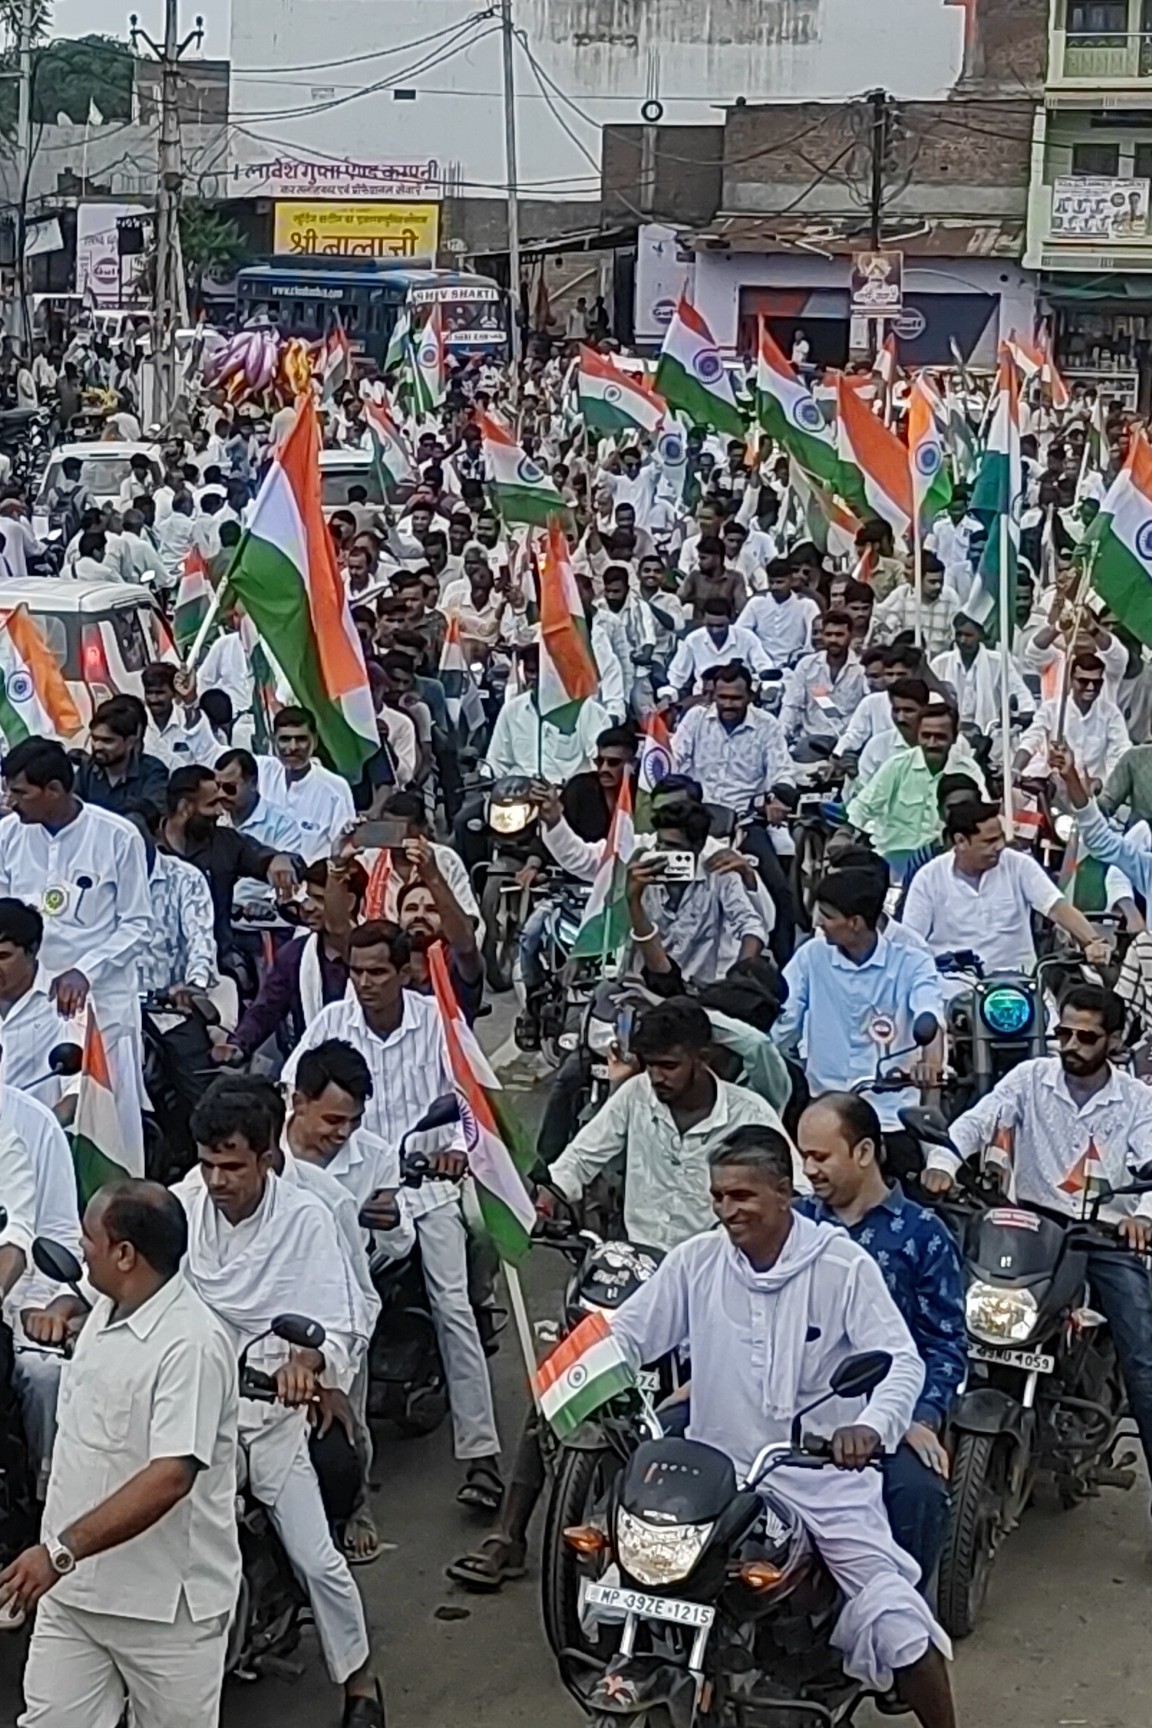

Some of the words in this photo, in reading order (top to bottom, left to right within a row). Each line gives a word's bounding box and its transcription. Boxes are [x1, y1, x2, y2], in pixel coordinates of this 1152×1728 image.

[289, 228, 318, 254] श्री
[600, 1589, 620, 1605] MP
[626, 1594, 666, 1616] 39ZE
[673, 1603, 711, 1624] 1215
